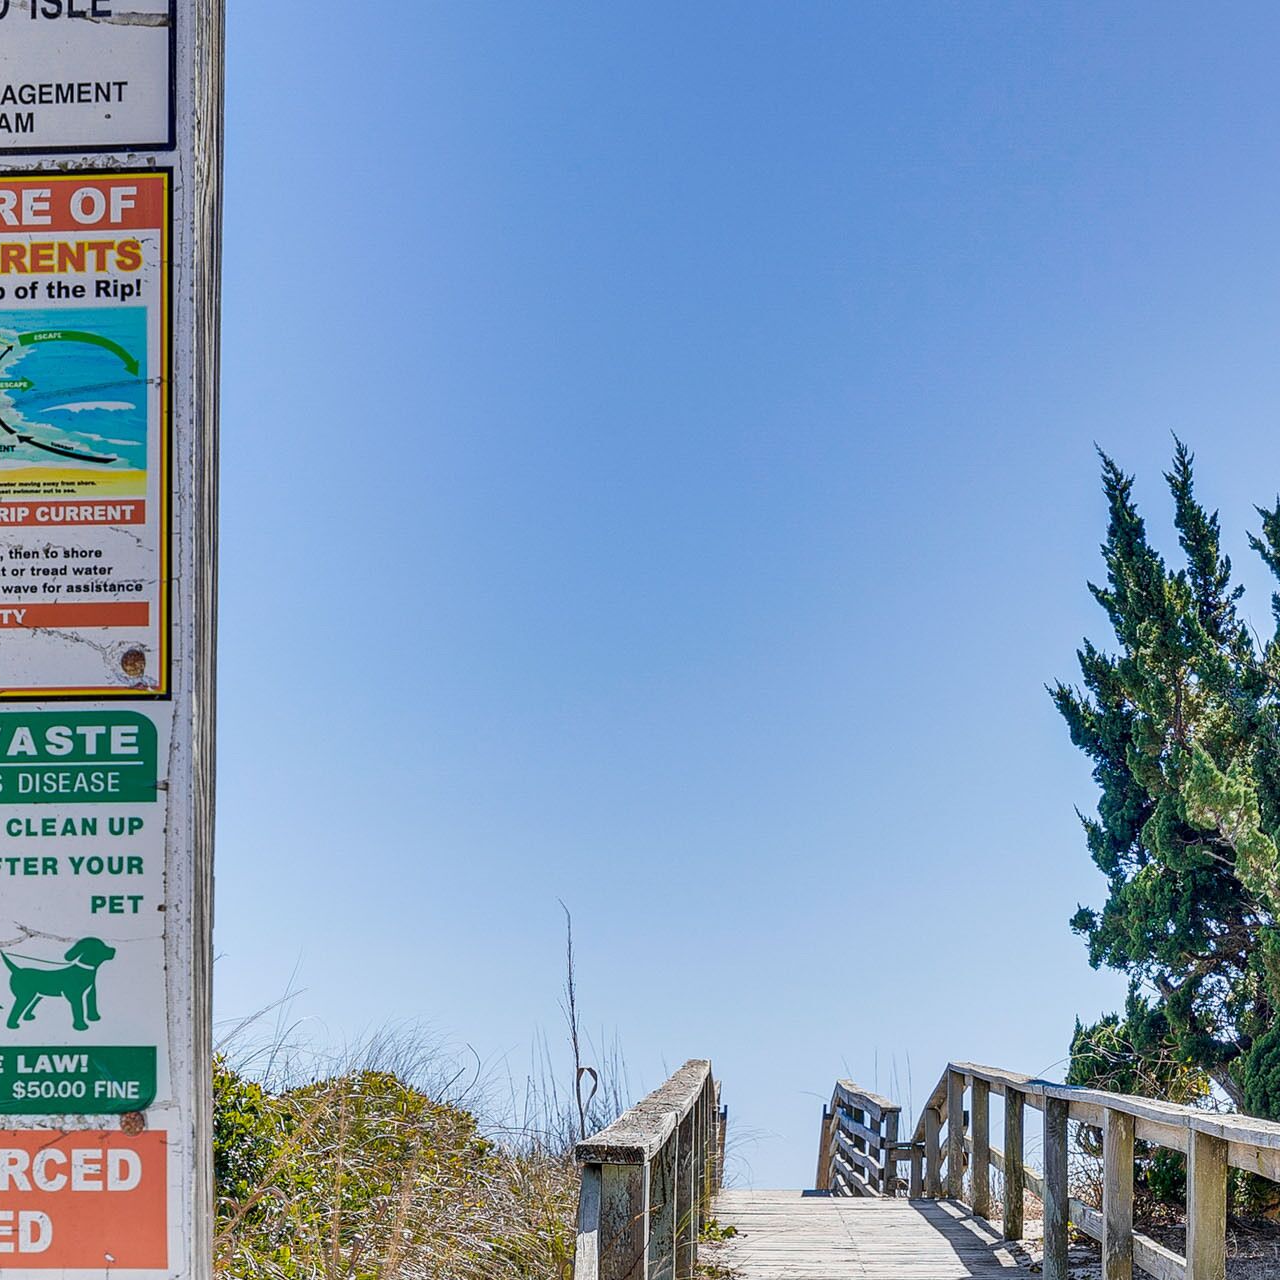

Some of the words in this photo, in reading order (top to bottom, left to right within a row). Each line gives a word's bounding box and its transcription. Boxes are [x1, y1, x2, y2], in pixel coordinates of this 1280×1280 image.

[69, 186, 137, 224] OF
[15, 280, 39, 300] of
[47, 281, 85, 299] the
[95, 279, 142, 300] Rip!
[34, 332, 62, 340] ESCAPE
[0, 381, 28, 389] ESCAPE
[35, 505, 135, 522] CURRENT
[9, 549, 39, 559] then
[45, 549, 58, 558] to
[63, 549, 102, 558] shore
[11, 567, 25, 576] or
[31, 566, 67, 575] tread
[72, 565, 112, 575] water
[2, 584, 38, 593] wave
[43, 583, 61, 593] for
[66, 582, 143, 592] assistance
[19, 772, 120, 793] DISEASE
[6, 818, 97, 836] CLEAN
[109, 817, 144, 835] UP
[68, 856, 144, 874] YOUR
[91, 895, 144, 914] PET
[17, 1055, 89, 1073] LAW!
[12, 1080, 86, 1098] $50.00
[94, 1081, 139, 1099] FINE
